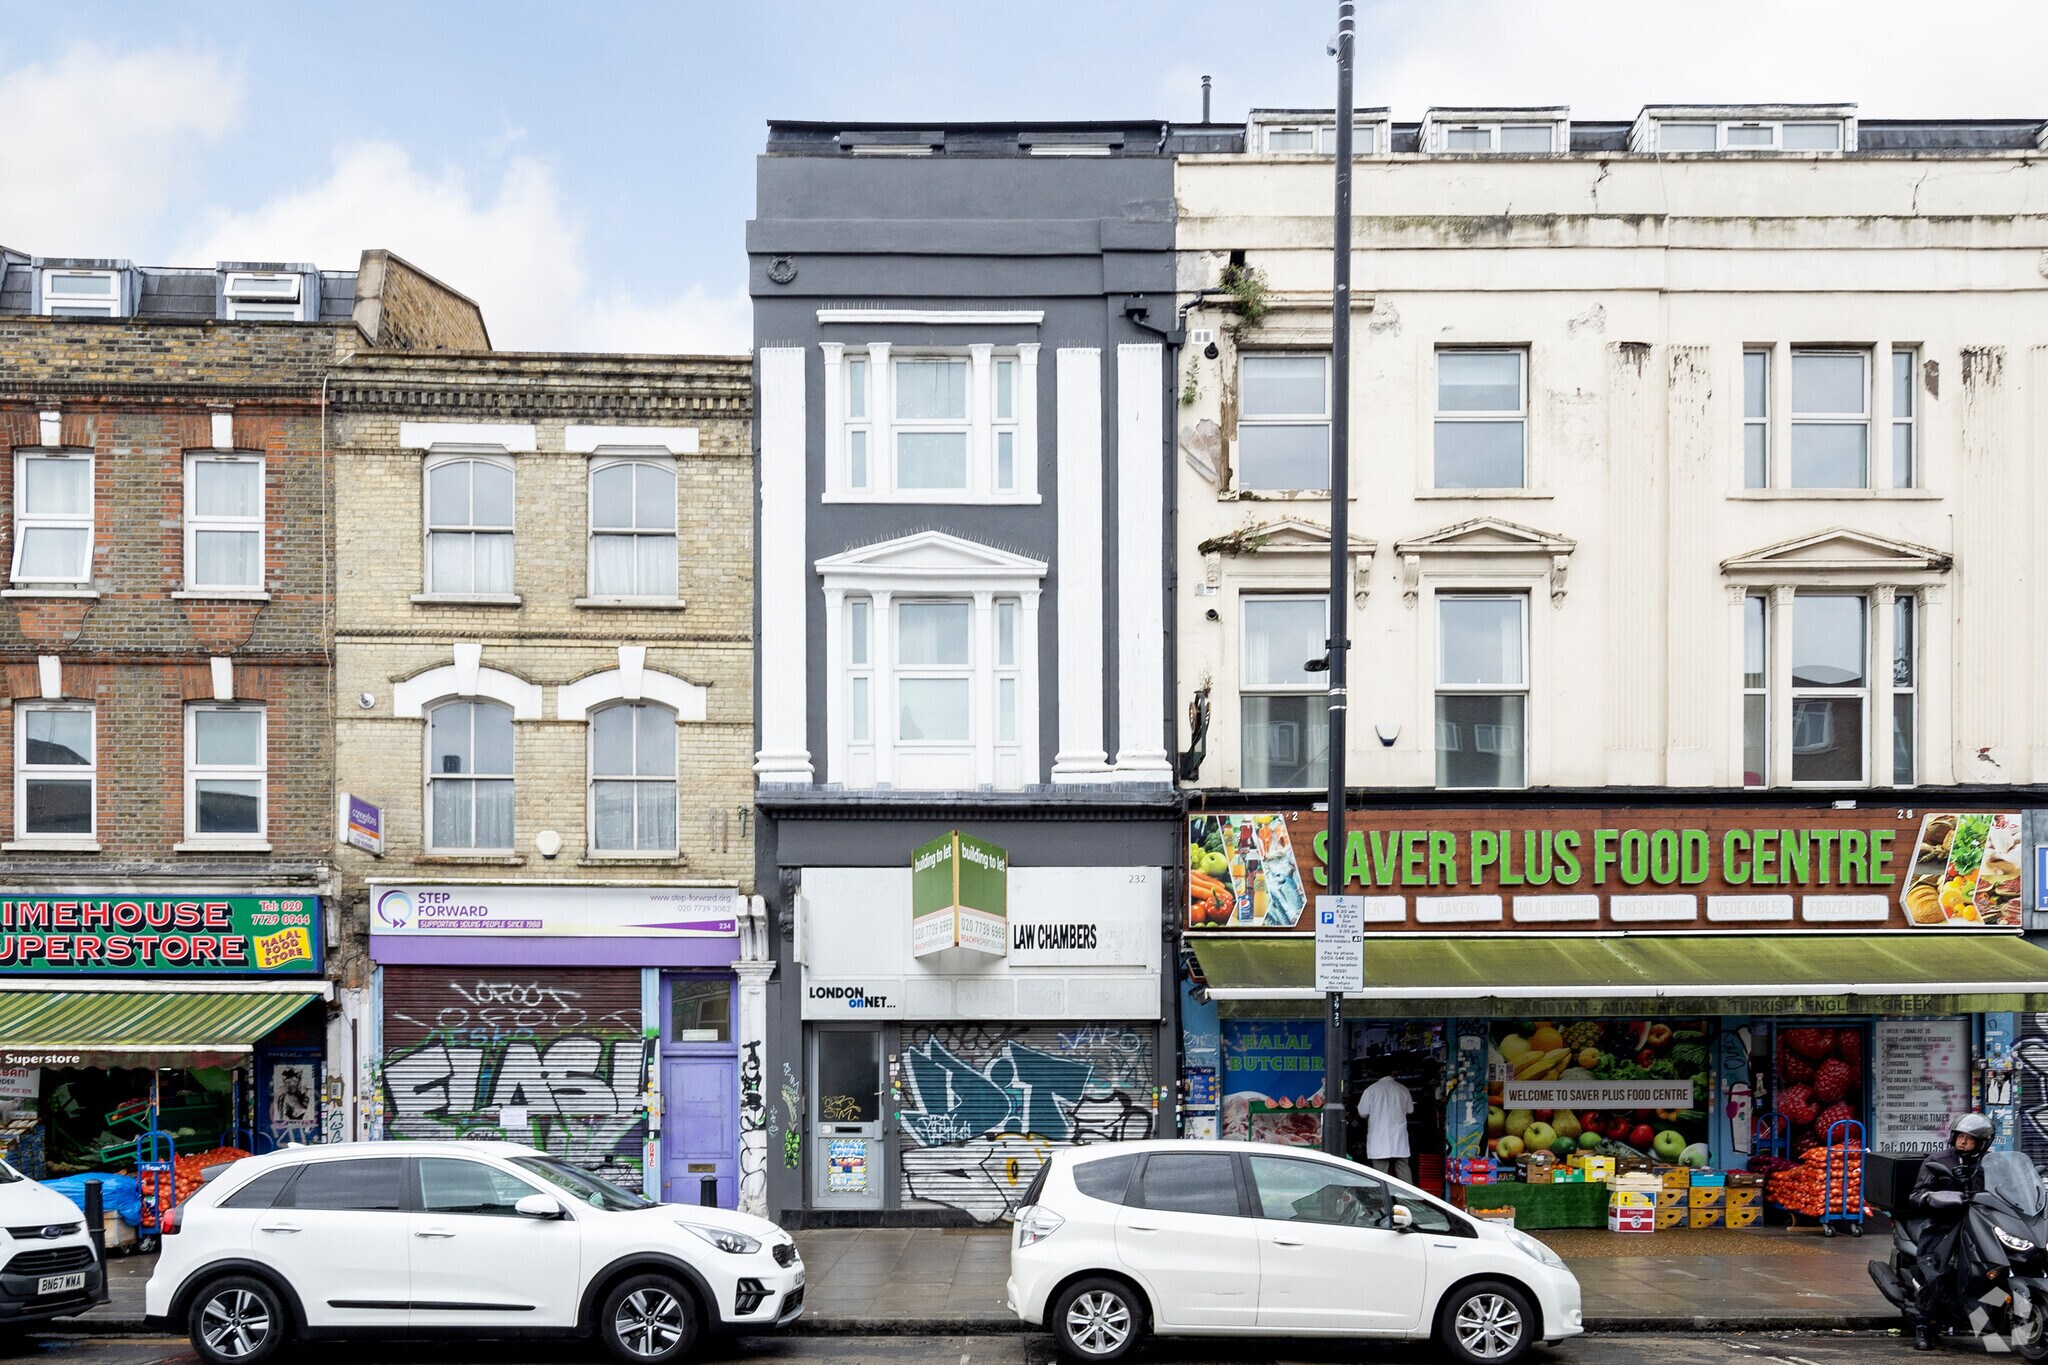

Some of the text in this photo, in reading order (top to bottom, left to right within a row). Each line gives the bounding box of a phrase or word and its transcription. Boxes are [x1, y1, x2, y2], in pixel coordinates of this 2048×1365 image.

[914, 843, 952, 873] building to let
[961, 843, 1005, 872] building to let
[1313, 829, 1896, 886] SAVER PLUS FOOD CENTRE
[1128, 875, 1146, 884] 232
[418, 892, 450, 904] STEP
[258, 900, 303, 912] Tel: 020
[418, 906, 488, 917] FORWARD
[1366, 901, 1481, 916] ERY BAKERY
[1516, 900, 1597, 916] HALAL BUTCHER
[1618, 900, 1688, 915] FRESH FRUIT
[1716, 900, 1785, 915] VEGETABLES
[1809, 900, 1881, 914] FROZEN FISH
[0, 901, 229, 927] IMEHOUSE
[251, 913, 310, 925] 7729 0944
[1324, 912, 1333, 923] P
[420, 920, 540, 928] SUPPORTING YOUNG PEOPLE SINCE 1988
[718, 922, 731, 930] 234
[961, 917, 973, 932] 020
[975, 921, 990, 936] 7739
[260, 930, 302, 948] HALAL
[1013, 923, 1097, 950] LAW CHAMBERS
[0, 935, 245, 960] UPERSTORE
[265, 939, 299, 956] FOOD
[265, 947, 304, 966] STORE
[809, 987, 864, 999] LONDON
[1600, 1001, 1645, 1014] ASIAN
[1730, 1000, 1795, 1013] TURKISH
[1882, 1000, 1932, 1012] GREEK
[1242, 1034, 1312, 1050] HALAL
[5, 1053, 80, 1066] Superstore
[1229, 1056, 1326, 1072] BUTCHER
[1509, 1088, 1688, 1101] WELCOME TO SAVER PLUS FOOD CENTRE
[1900, 1113, 1950, 1122] OPENING TIMES
[1880, 1141, 1898, 1152] Tel:
[1900, 1141, 1918, 1152] 020
[1920, 1141, 1944, 1152] 7059
